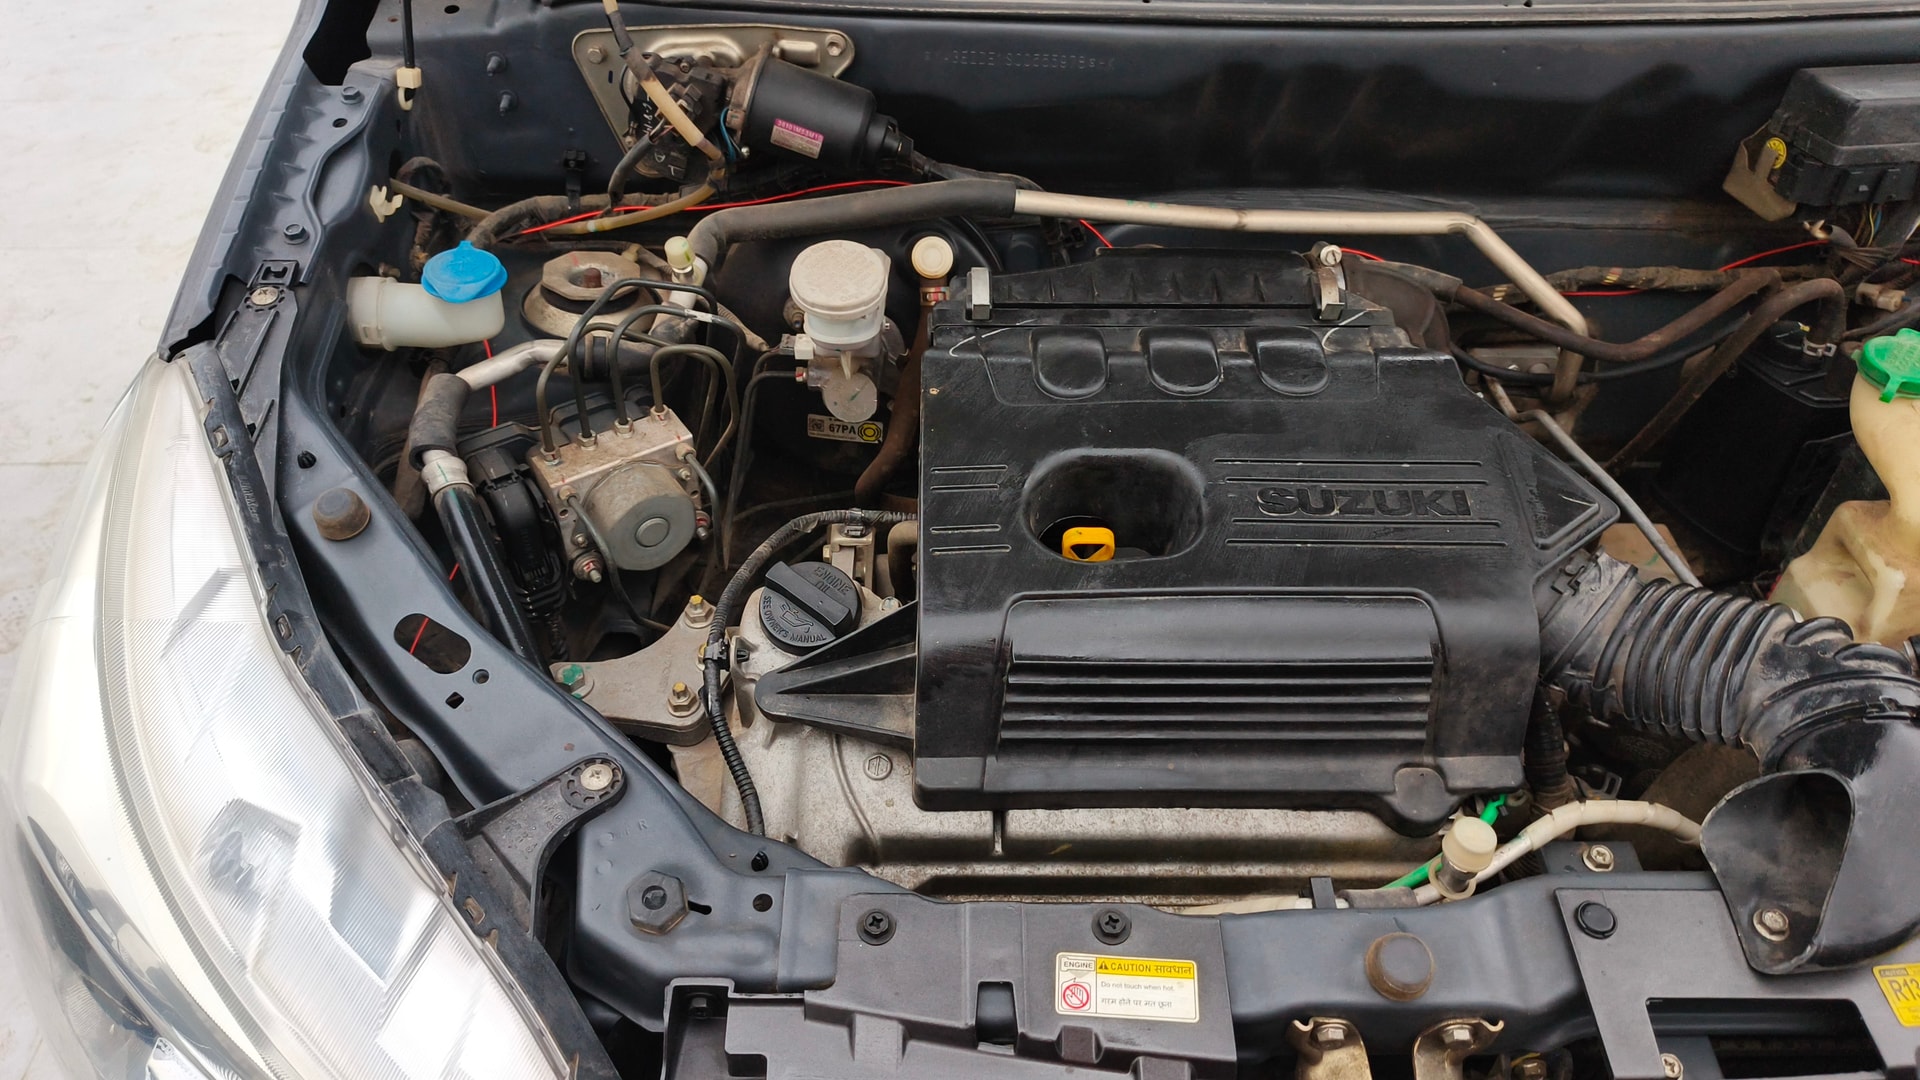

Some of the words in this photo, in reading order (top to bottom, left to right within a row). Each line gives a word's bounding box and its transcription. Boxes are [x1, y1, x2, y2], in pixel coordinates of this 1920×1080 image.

[828, 423, 857, 435] 67PA
[1257, 487, 1472, 516] SUZUKI
[814, 566, 853, 596] ENGINE
[763, 595, 773, 610] SEE
[789, 633, 827, 644] MANUAL
[1063, 960, 1094, 969] ENGINE
[1110, 962, 1151, 972] CAUTION
[1154, 964, 1192, 975] सावधान
[1101, 980, 1111, 988] Do
[1112, 981, 1123, 989] not
[1124, 981, 1142, 990] touch
[1143, 983, 1161, 991] when
[1162, 983, 1175, 992] hot.
